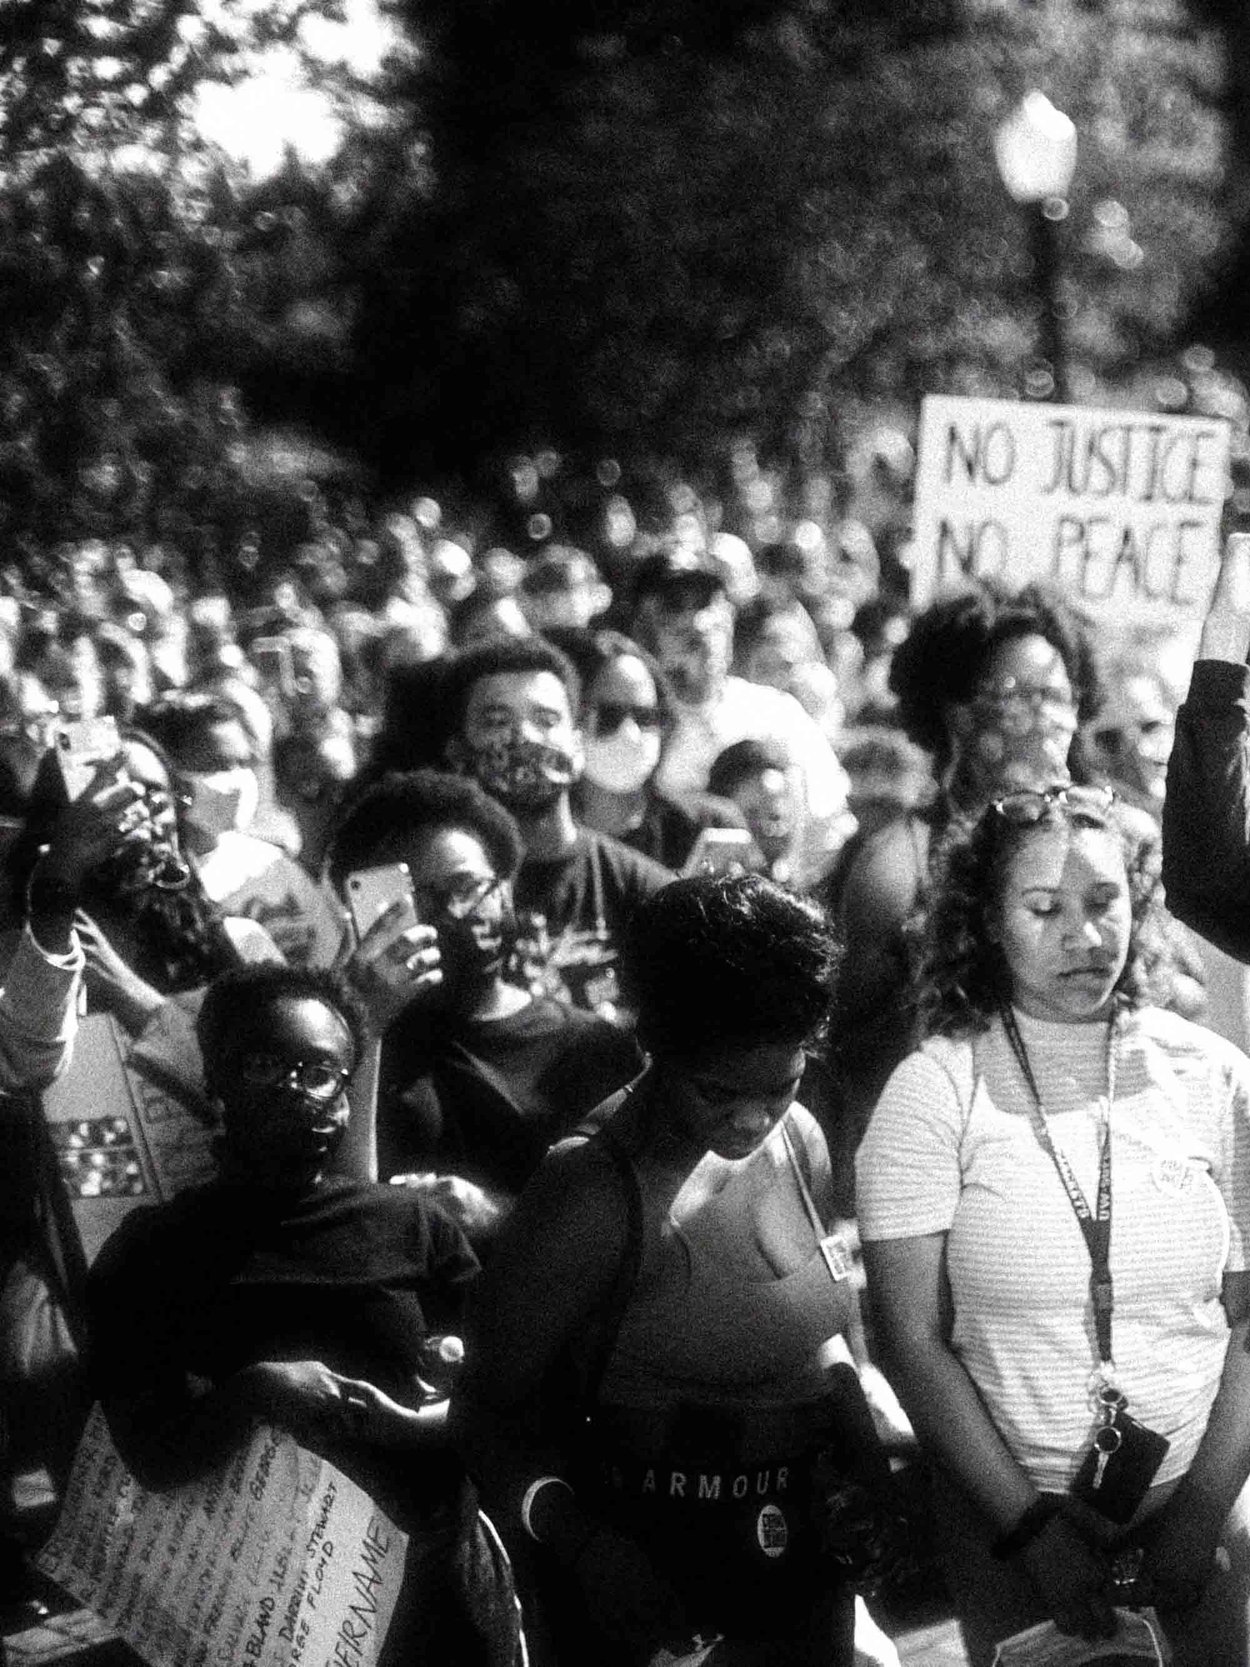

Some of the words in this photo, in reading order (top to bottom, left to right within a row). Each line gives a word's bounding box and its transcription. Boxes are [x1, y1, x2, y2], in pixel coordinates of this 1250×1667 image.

[944, 422, 1017, 486] NO
[1039, 419, 1219, 506] JUSTICE
[936, 518, 1009, 578] NO
[1051, 513, 1209, 606] PEACE
[304, 1478, 338, 1559] STEWART
[642, 1466, 790, 1500] ARMOUR
[307, 1539, 332, 1610] FLOYD
[242, 1595, 275, 1659] BLAND
